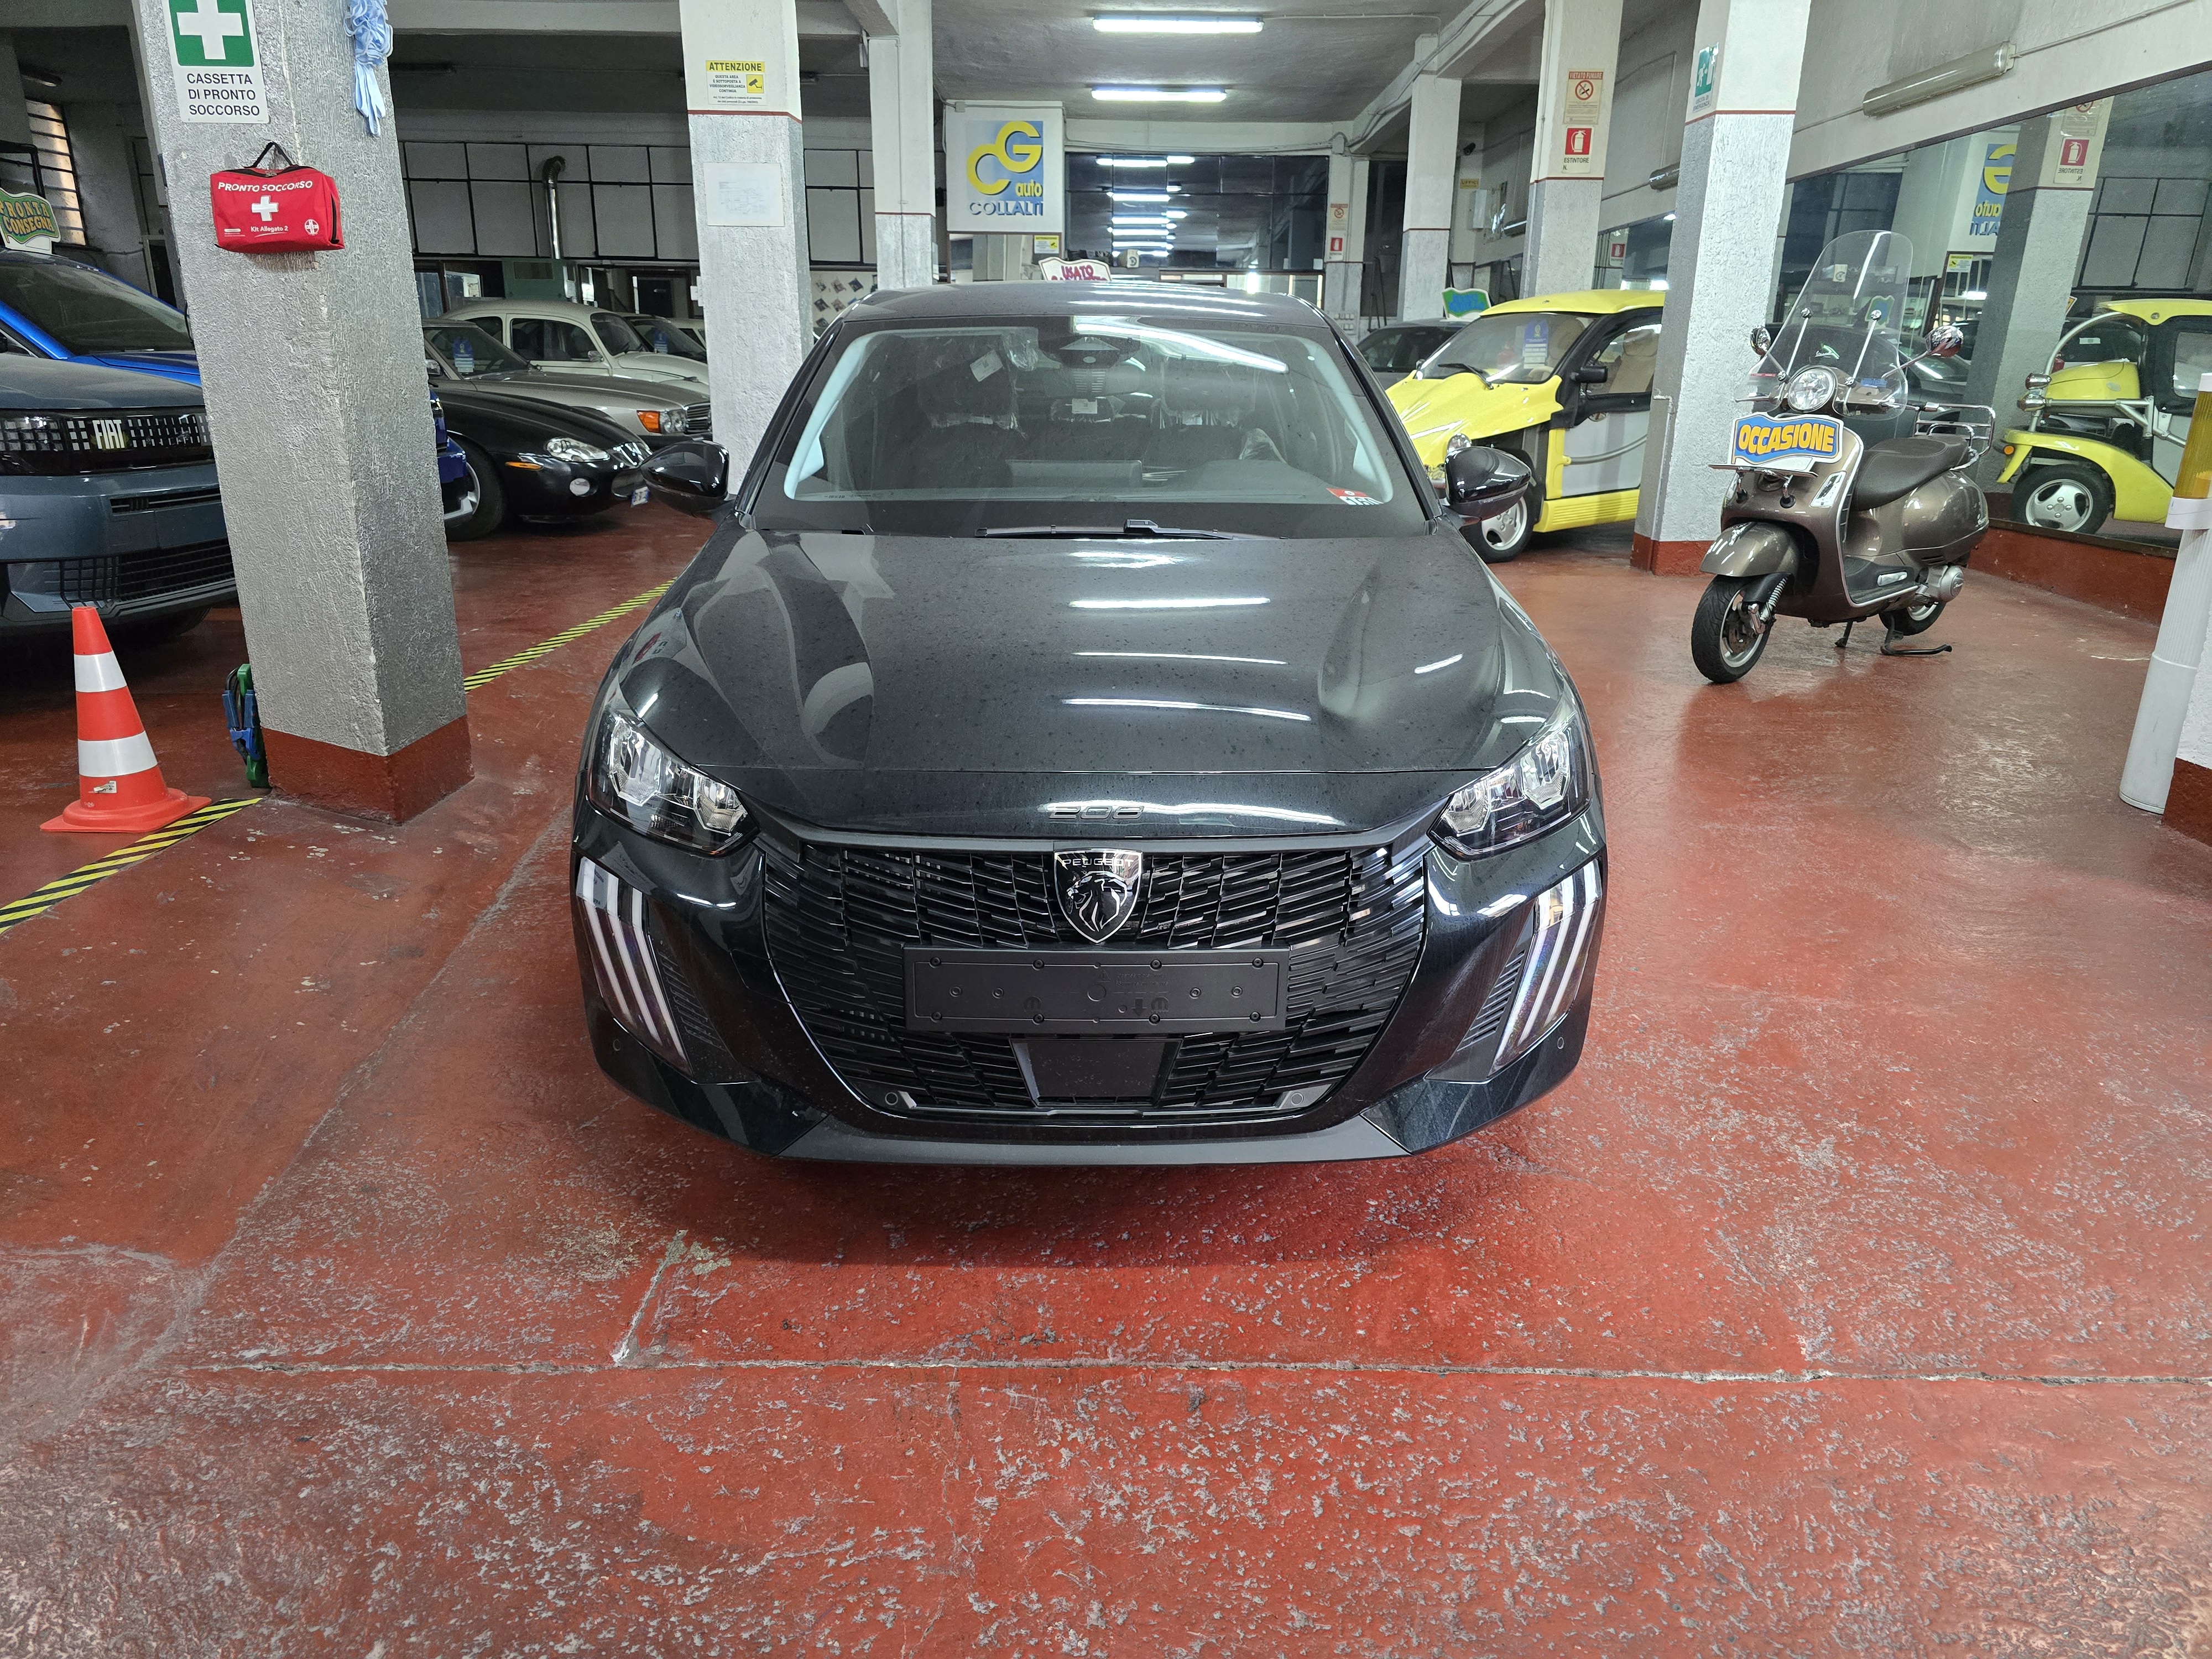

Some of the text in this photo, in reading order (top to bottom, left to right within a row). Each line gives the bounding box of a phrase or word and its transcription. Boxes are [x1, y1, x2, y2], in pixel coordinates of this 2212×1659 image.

[709, 62, 762, 71] ATTENZIONE
[186, 73, 253, 85] CASSETTA
[188, 89, 256, 100] DI PRONTO
[189, 105, 260, 116] SOCCORSO
[218, 180, 313, 192] PRONTO SOCCORSO
[1015, 179, 1043, 197] auto
[969, 200, 1044, 216] COLLALTI
[3, 215, 55, 234] CONSEGNA
[1061, 264, 1094, 280] USATO
[92, 419, 126, 450] FIAT
[1737, 422, 1836, 455] OCCASIONE
[1049, 805, 1145, 820] 208
[1062, 858, 1134, 867] PEUGEOT
